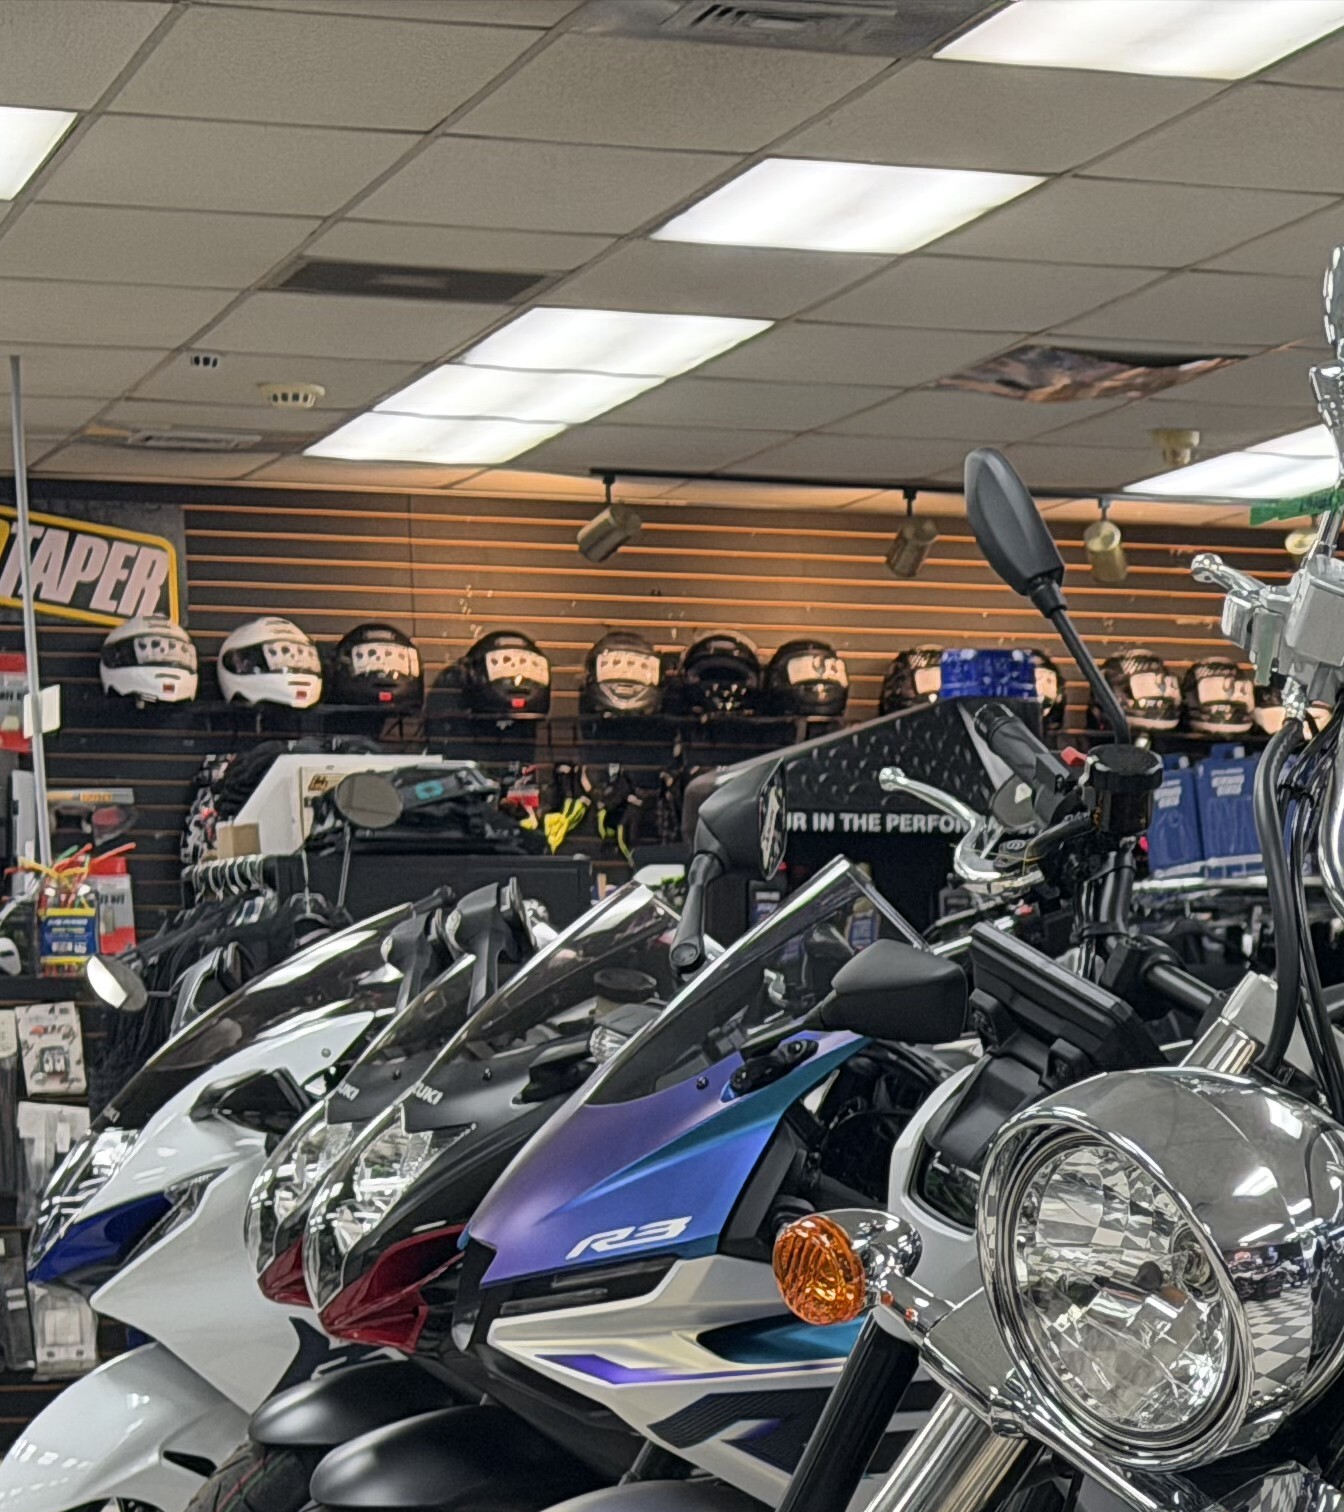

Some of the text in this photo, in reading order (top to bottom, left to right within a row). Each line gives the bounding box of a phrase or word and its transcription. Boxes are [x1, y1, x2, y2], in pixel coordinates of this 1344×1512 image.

[0, 522, 169, 617] TAPER
[813, 813, 834, 831] IN
[839, 813, 880, 832] THE
[566, 1216, 693, 1260] R3
